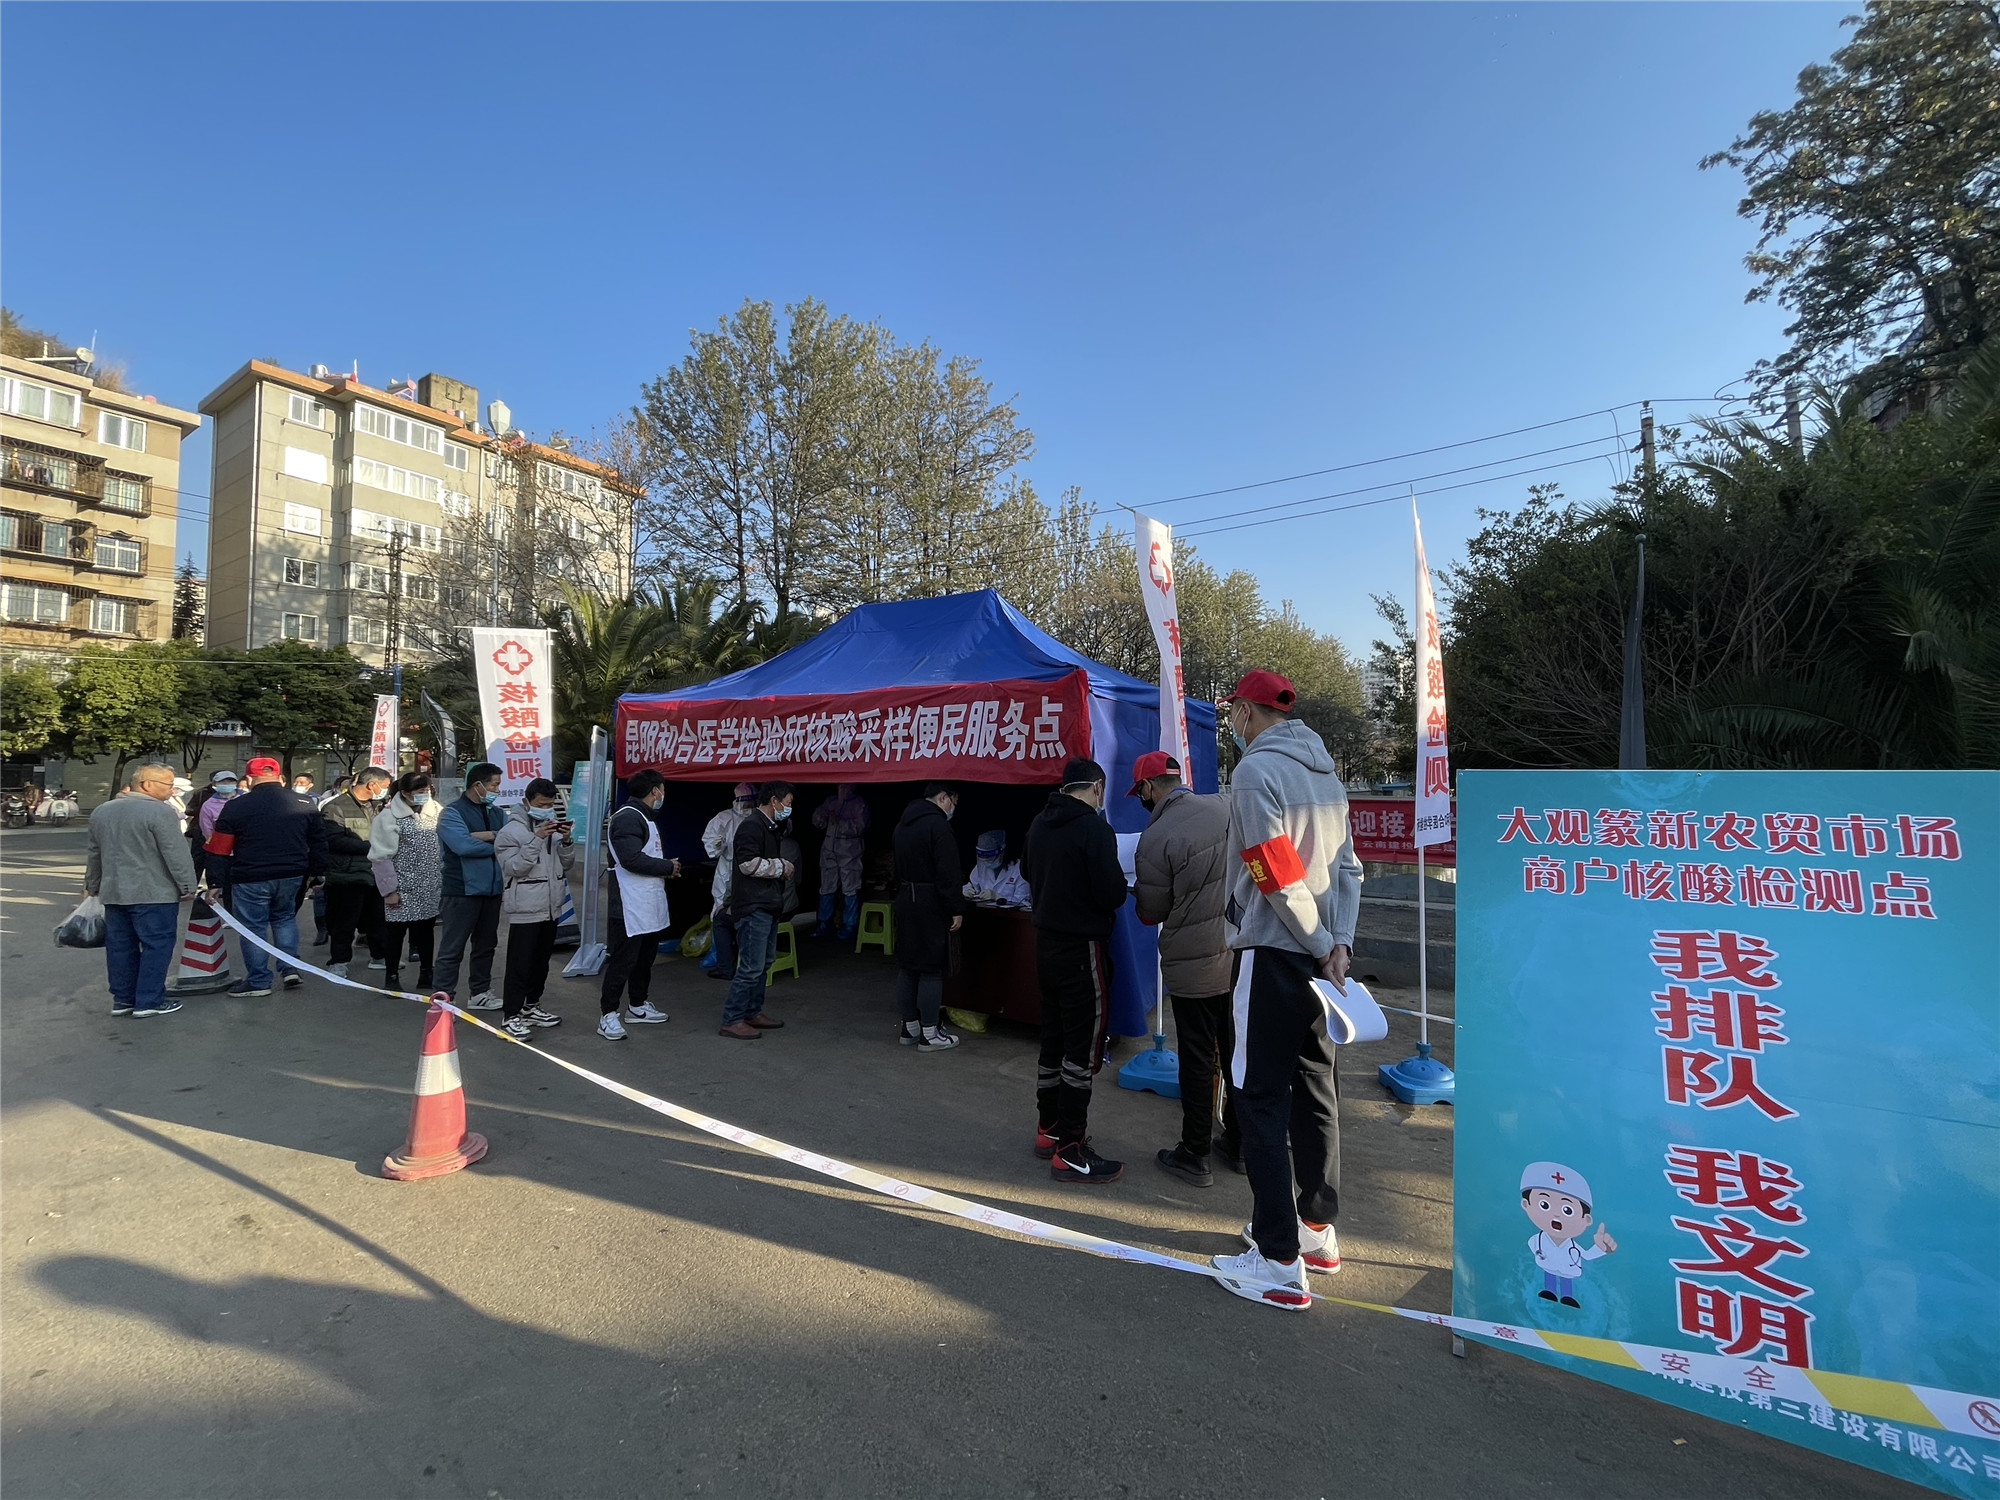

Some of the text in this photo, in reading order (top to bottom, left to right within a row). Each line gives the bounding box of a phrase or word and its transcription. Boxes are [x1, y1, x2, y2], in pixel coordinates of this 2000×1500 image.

[624, 695, 1066, 764] 昆明和合医学检验所核酸采样便民服务点
[1498, 807, 1962, 861] 大观篆新农贸市场
[1523, 855, 1938, 919] 商户核酸检测点
[1649, 929, 1815, 1368] 我排队 我文明
[1660, 1353, 1776, 1391] 安全
